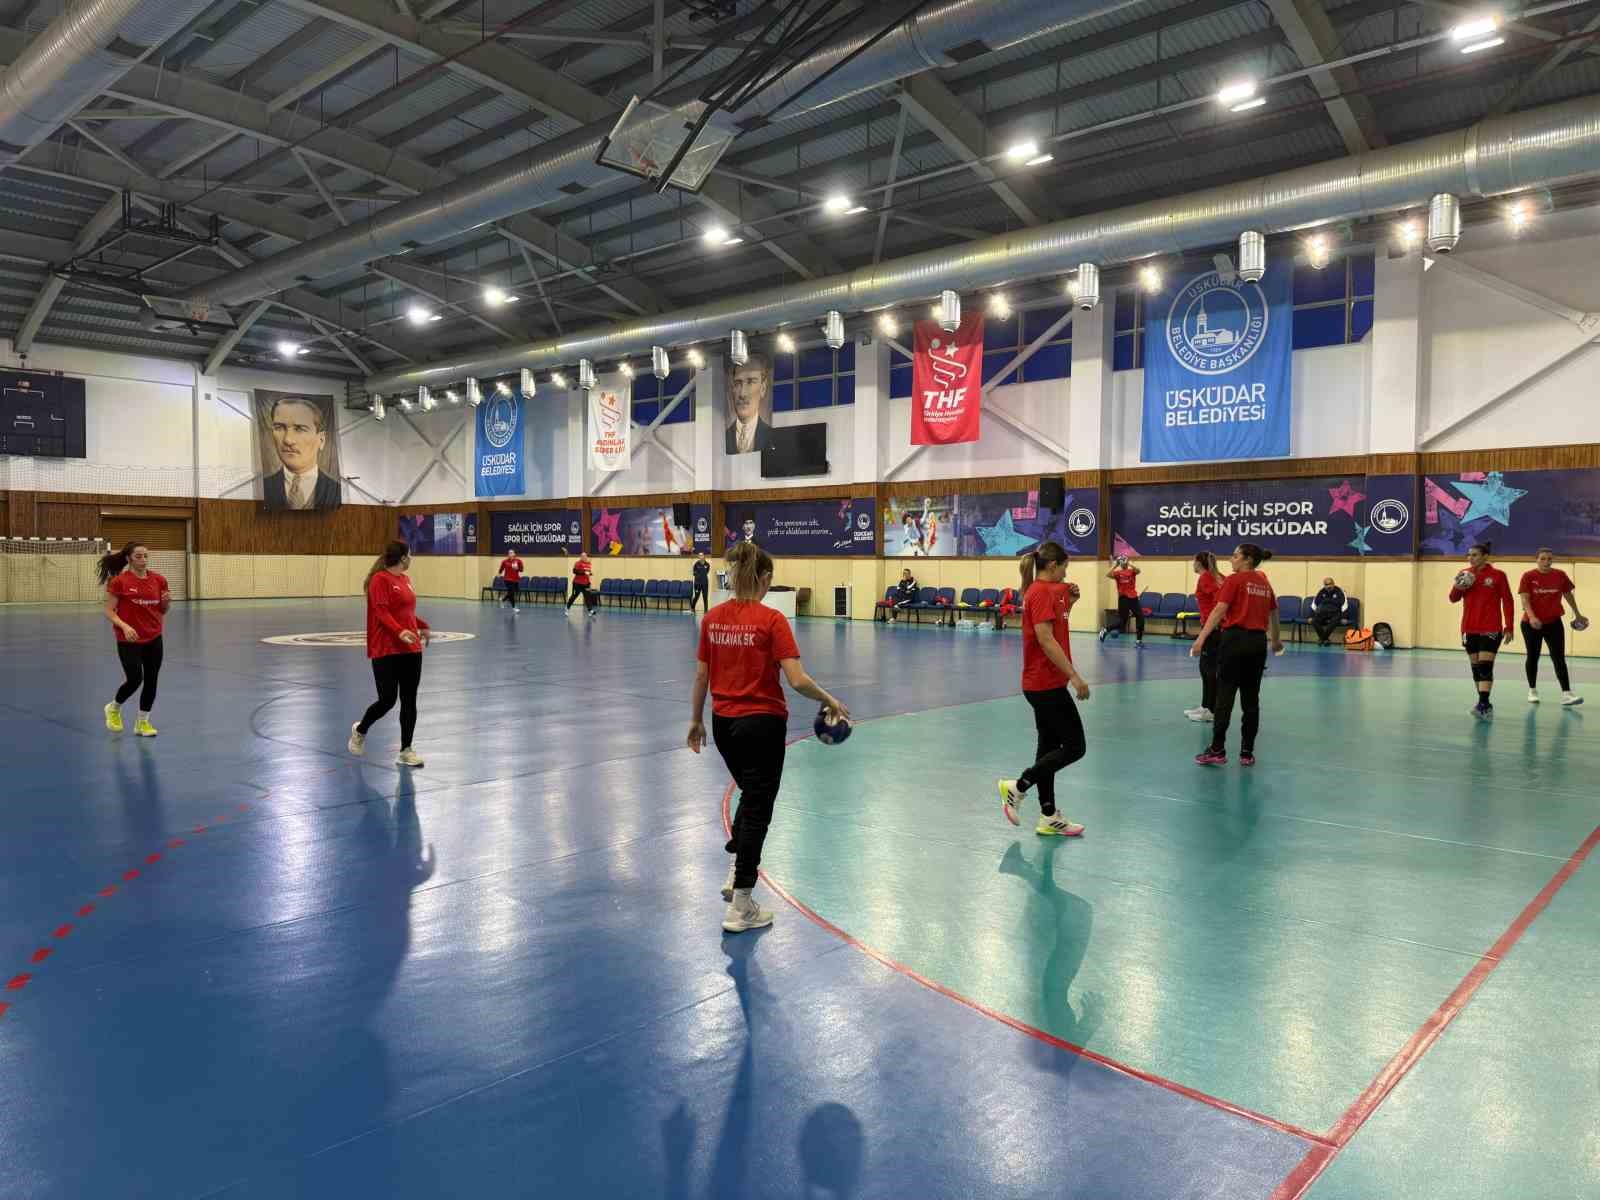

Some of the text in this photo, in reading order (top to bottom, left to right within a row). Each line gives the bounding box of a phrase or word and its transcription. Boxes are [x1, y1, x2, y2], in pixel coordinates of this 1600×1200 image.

[923, 387, 968, 409] THF
[1166, 383, 1267, 409] ÜSKÜDAR
[1165, 404, 1267, 427] BELEDİYESİ
[1159, 500, 1313, 521] SAĞLIK İÇİN SPOR
[504, 535, 520, 543] SPOR
[535, 533, 566, 543] ÜSKÜDAR
[508, 522, 529, 532] SAĞLIK
[544, 523, 562, 531] SPOR
[1146, 518, 1328, 540] SPOR İÇİN ÜSKÜDAR
